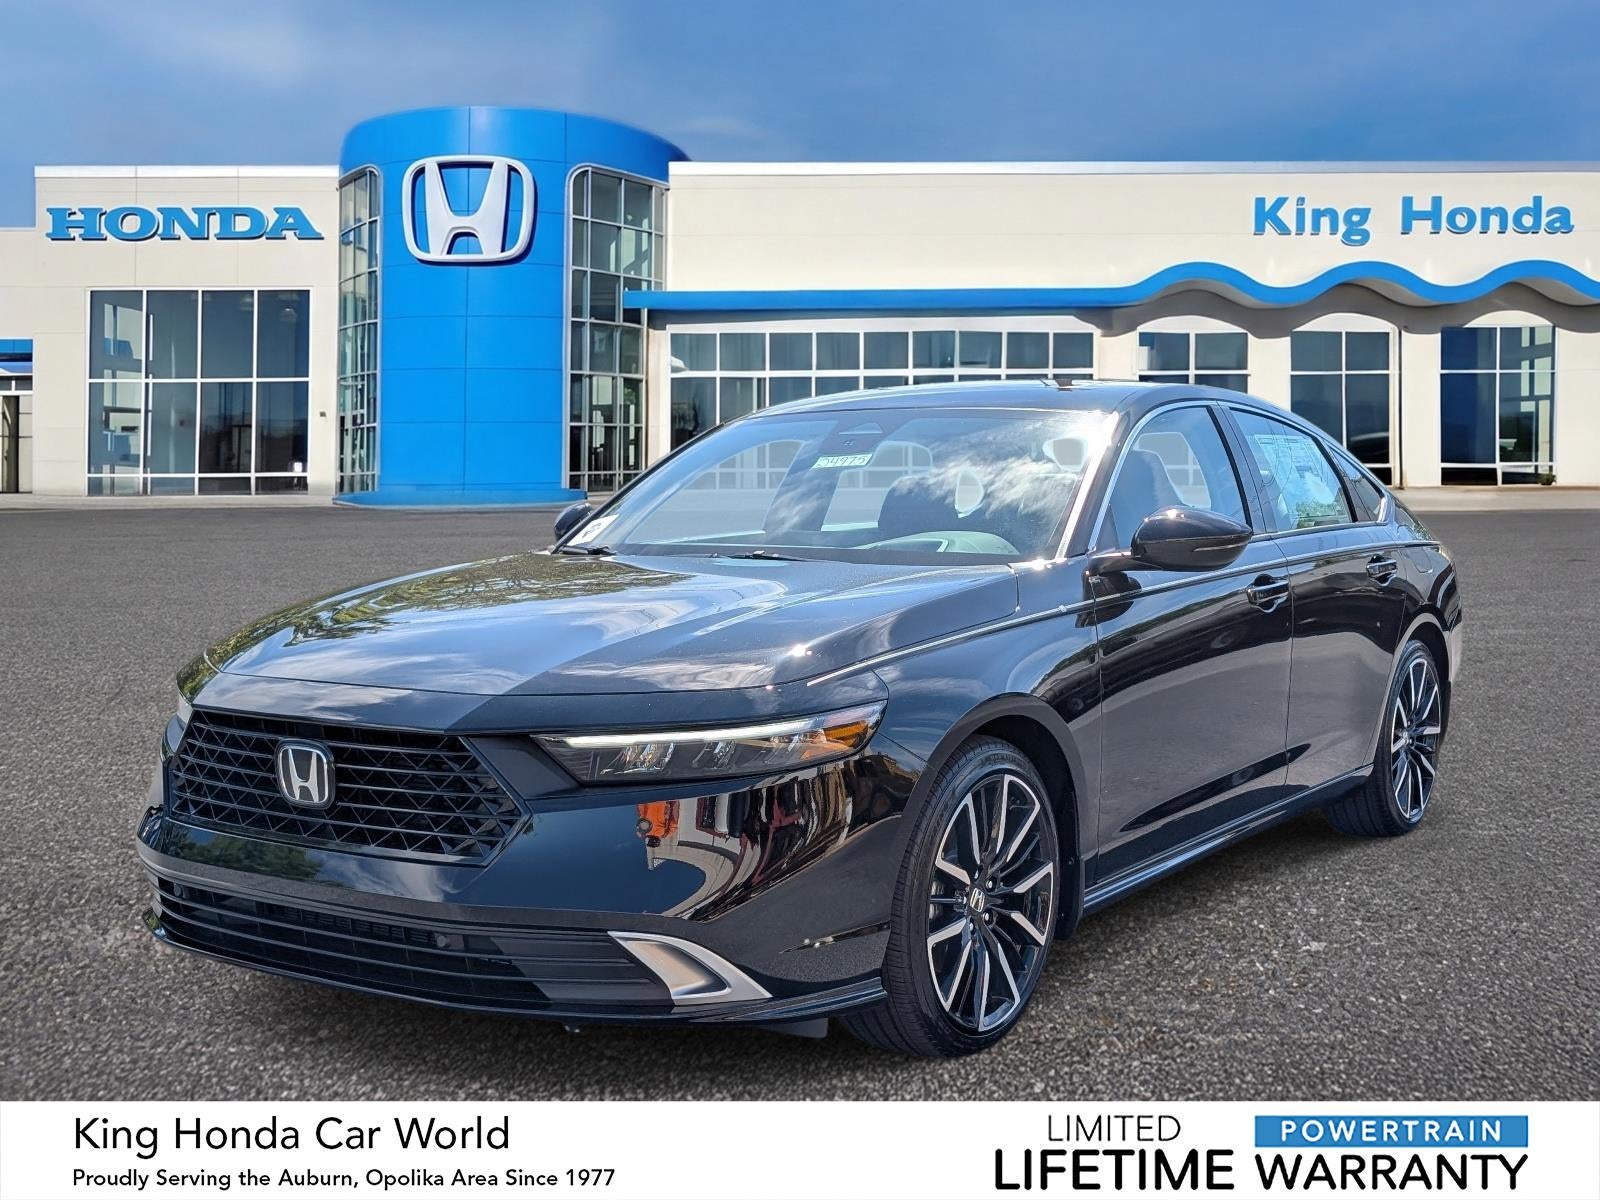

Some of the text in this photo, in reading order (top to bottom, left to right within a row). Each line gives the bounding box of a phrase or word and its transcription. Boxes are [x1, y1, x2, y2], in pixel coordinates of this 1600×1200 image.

[45, 205, 325, 242] HONDA
[1253, 195, 1575, 246] King Honda
